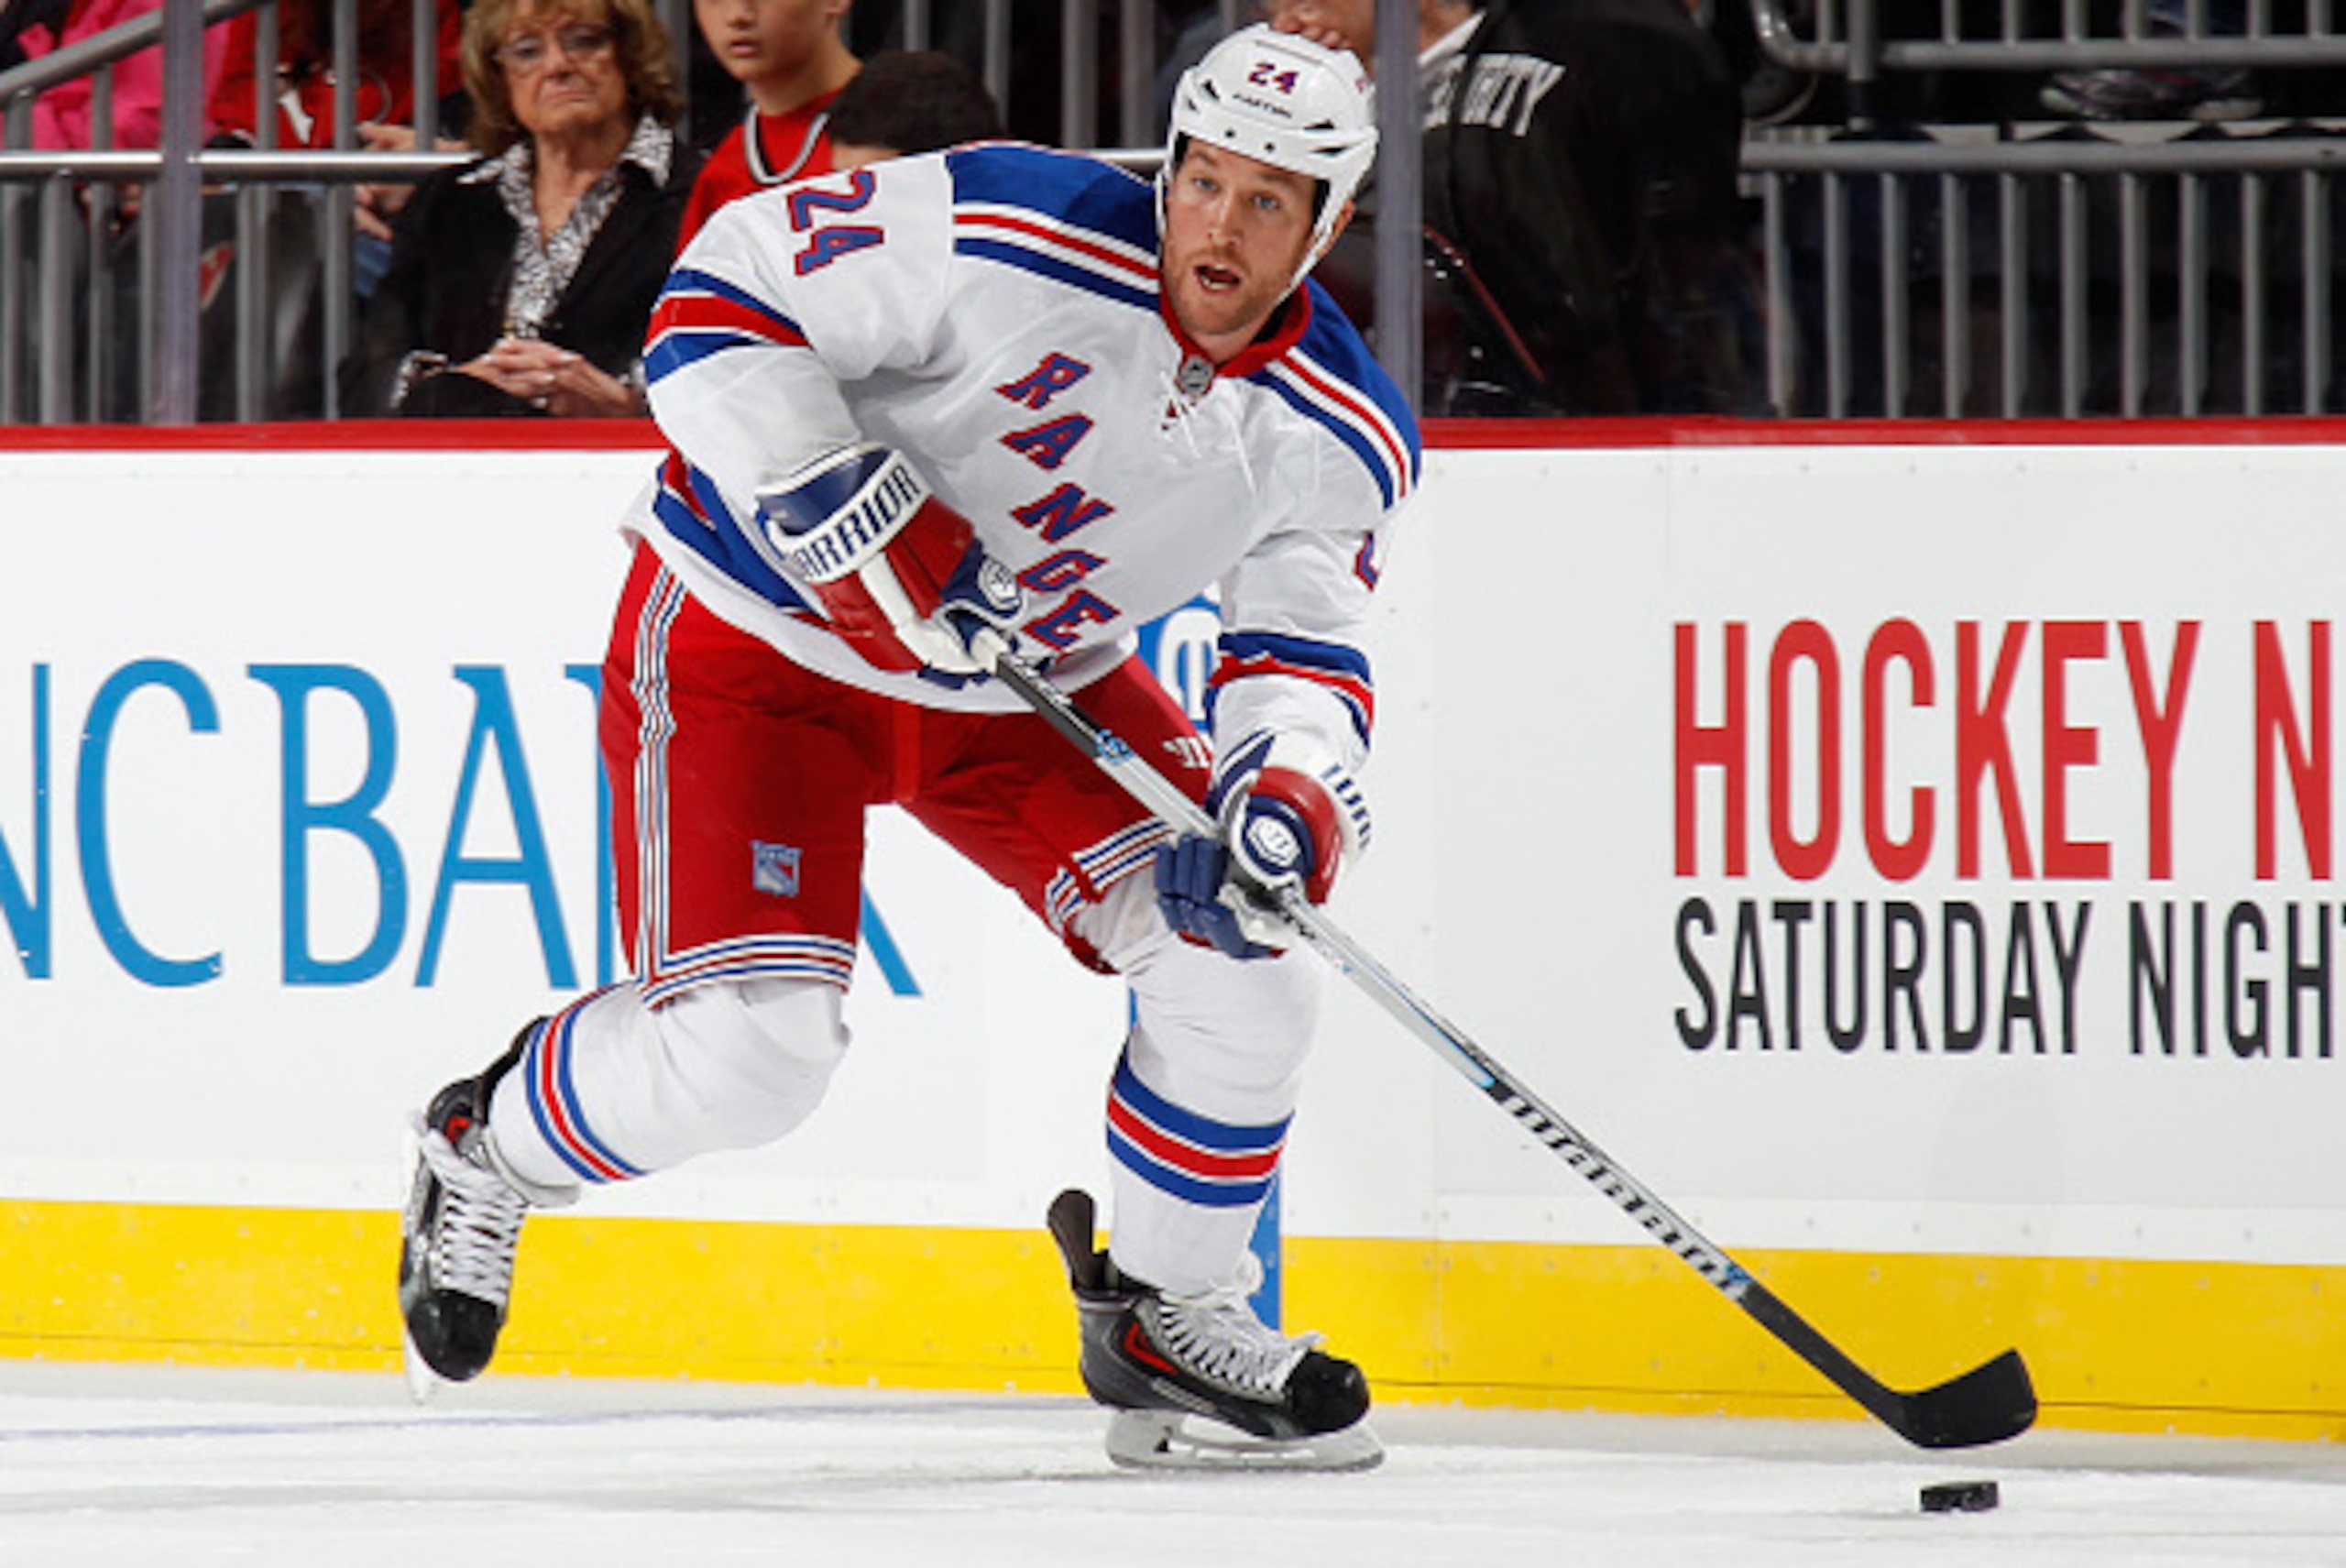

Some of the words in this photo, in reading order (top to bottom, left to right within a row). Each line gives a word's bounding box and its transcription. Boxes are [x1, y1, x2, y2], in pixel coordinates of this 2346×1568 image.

[1248, 61, 1299, 94] 24
[787, 169, 883, 276] 24
[794, 464, 920, 577] ARRIOR
[992, 351, 1122, 665] RANGE
[246, 663, 923, 997] BA
[1673, 617, 2203, 883] HOCKEY
[2252, 620, 2332, 881] N
[1673, 896, 2093, 1054] SATURDAY
[2129, 900, 2346, 1058] NIGH
